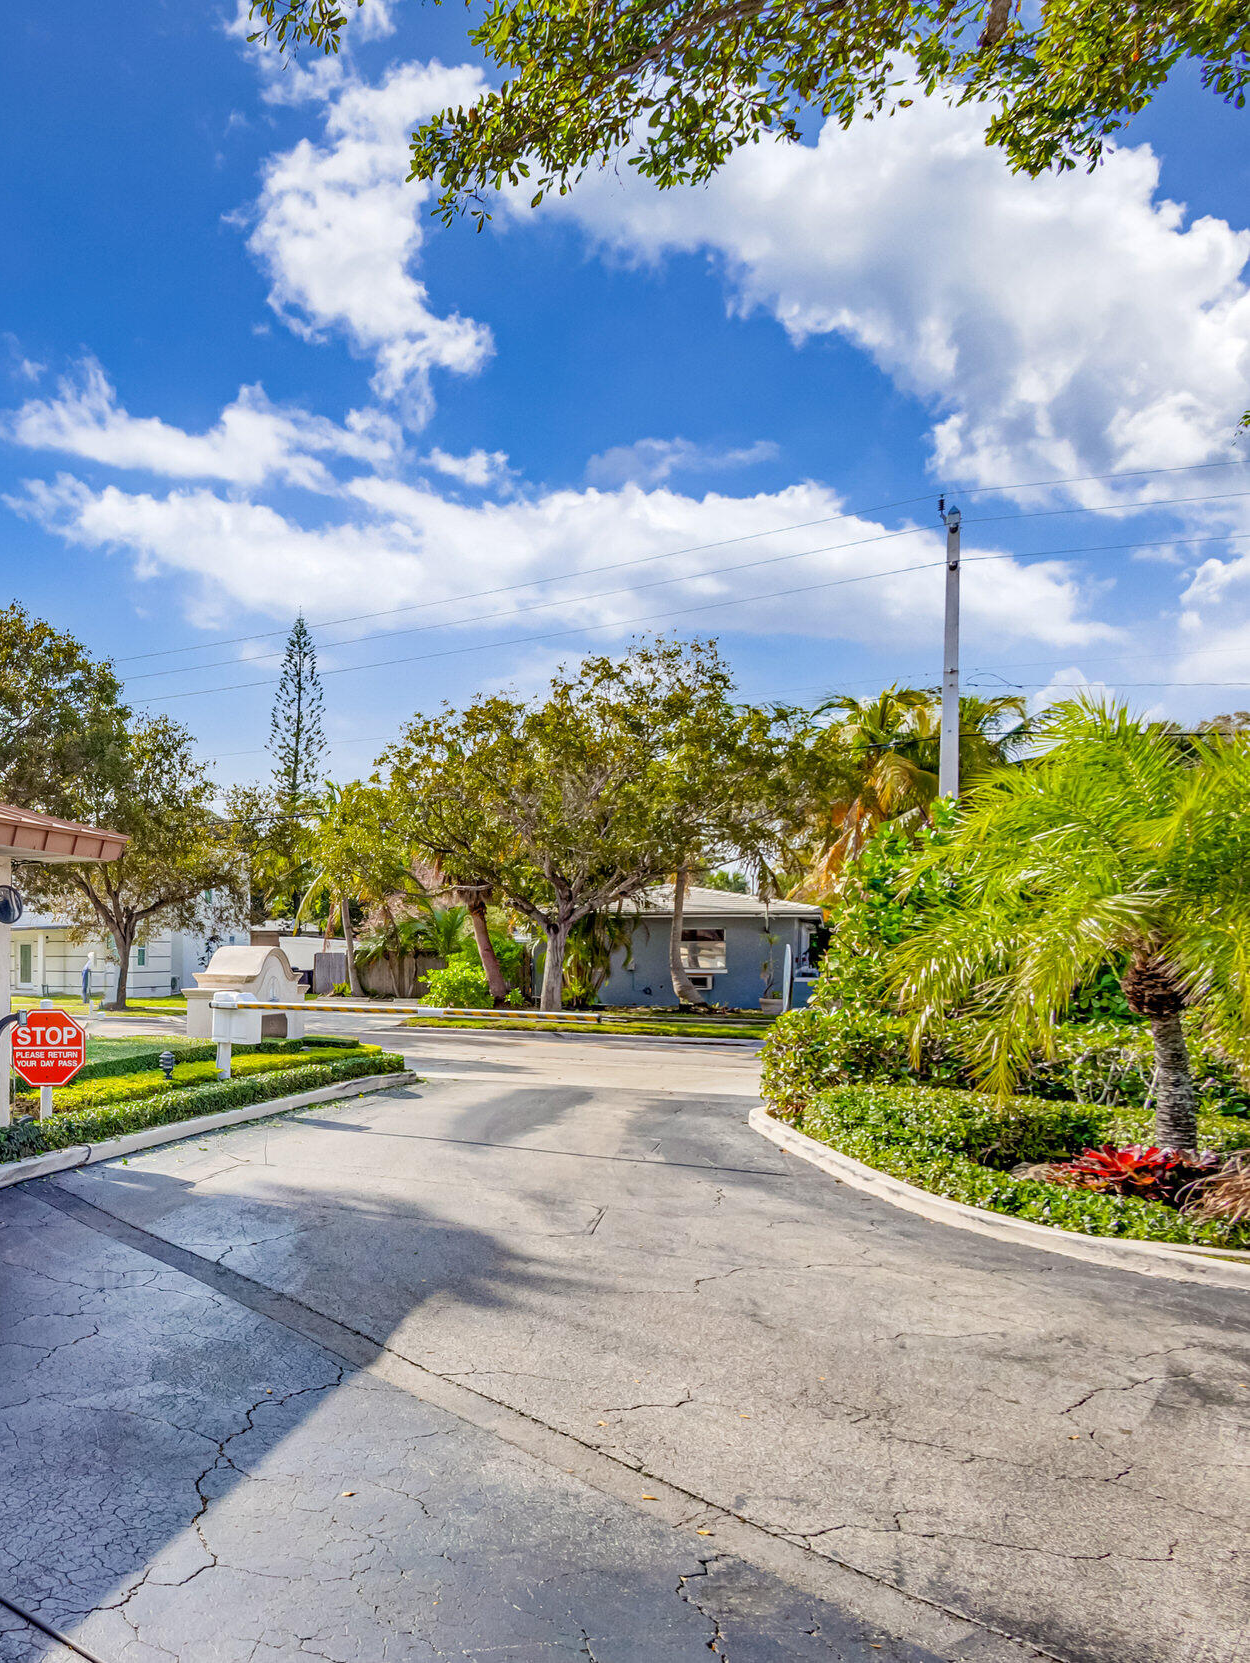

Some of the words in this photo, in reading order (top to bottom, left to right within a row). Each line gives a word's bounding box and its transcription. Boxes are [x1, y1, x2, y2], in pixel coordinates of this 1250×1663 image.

[16, 1026, 77, 1045] STOP
[16, 1051, 45, 1059] PLEASE
[48, 1051, 78, 1059] RETURN
